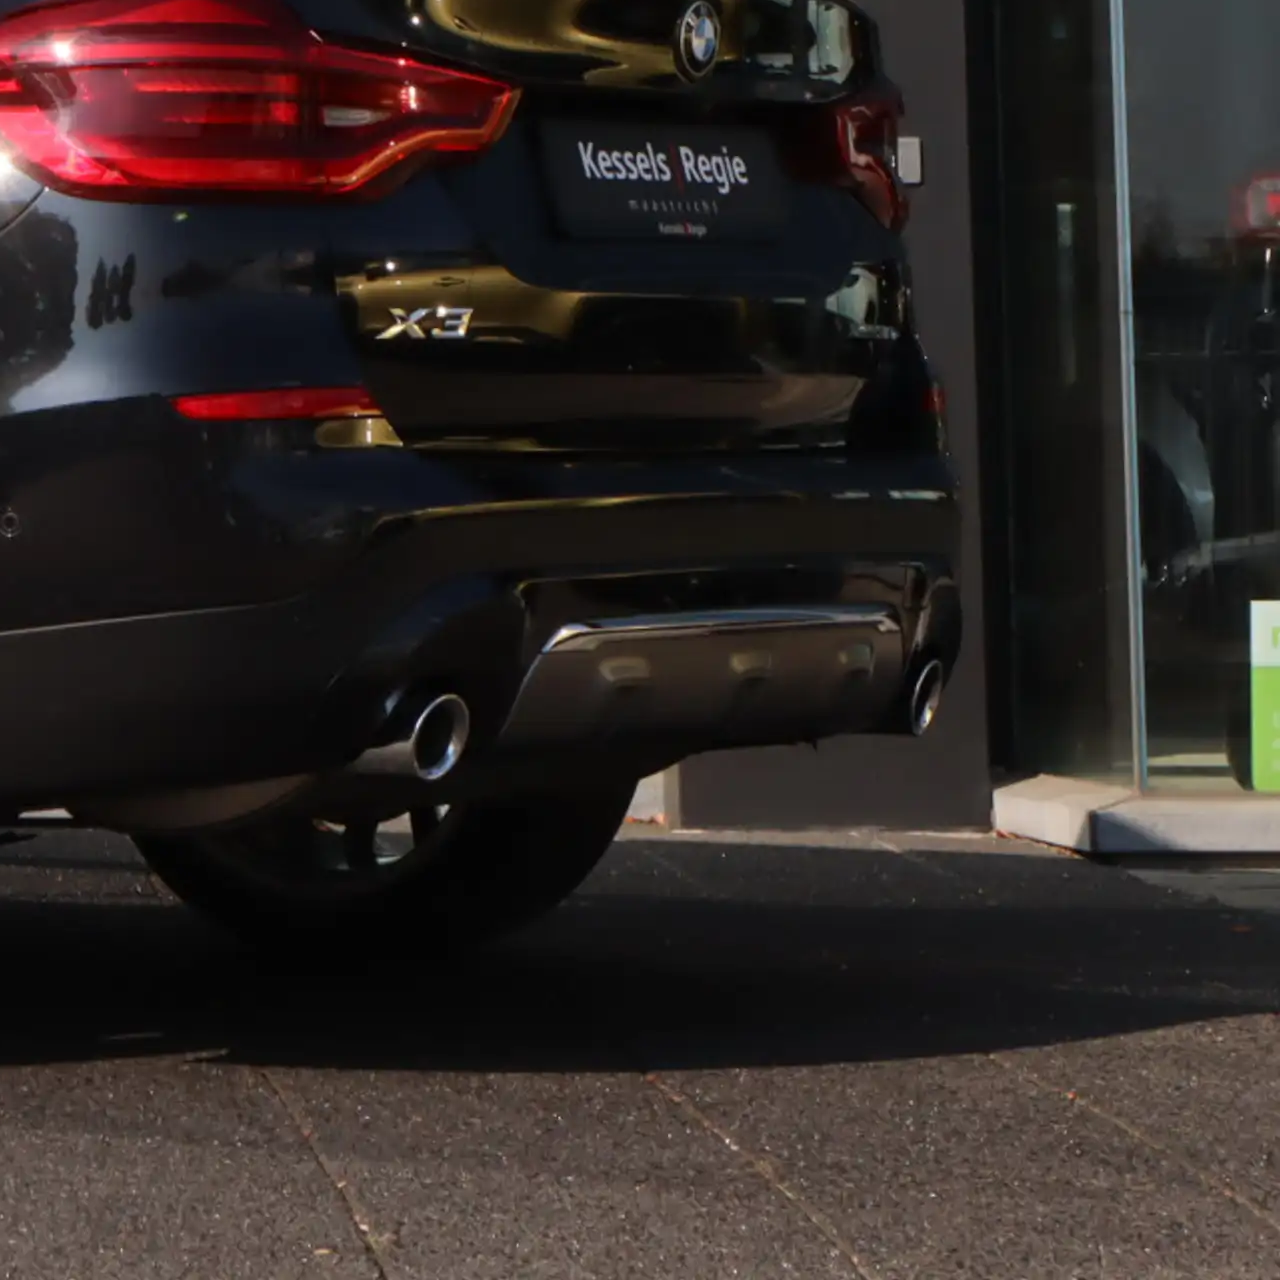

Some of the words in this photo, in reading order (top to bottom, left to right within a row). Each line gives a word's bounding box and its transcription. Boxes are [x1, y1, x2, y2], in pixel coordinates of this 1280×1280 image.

[577, 140, 672, 182] Kessels
[679, 145, 749, 195] Regie
[374, 305, 474, 340] X3
